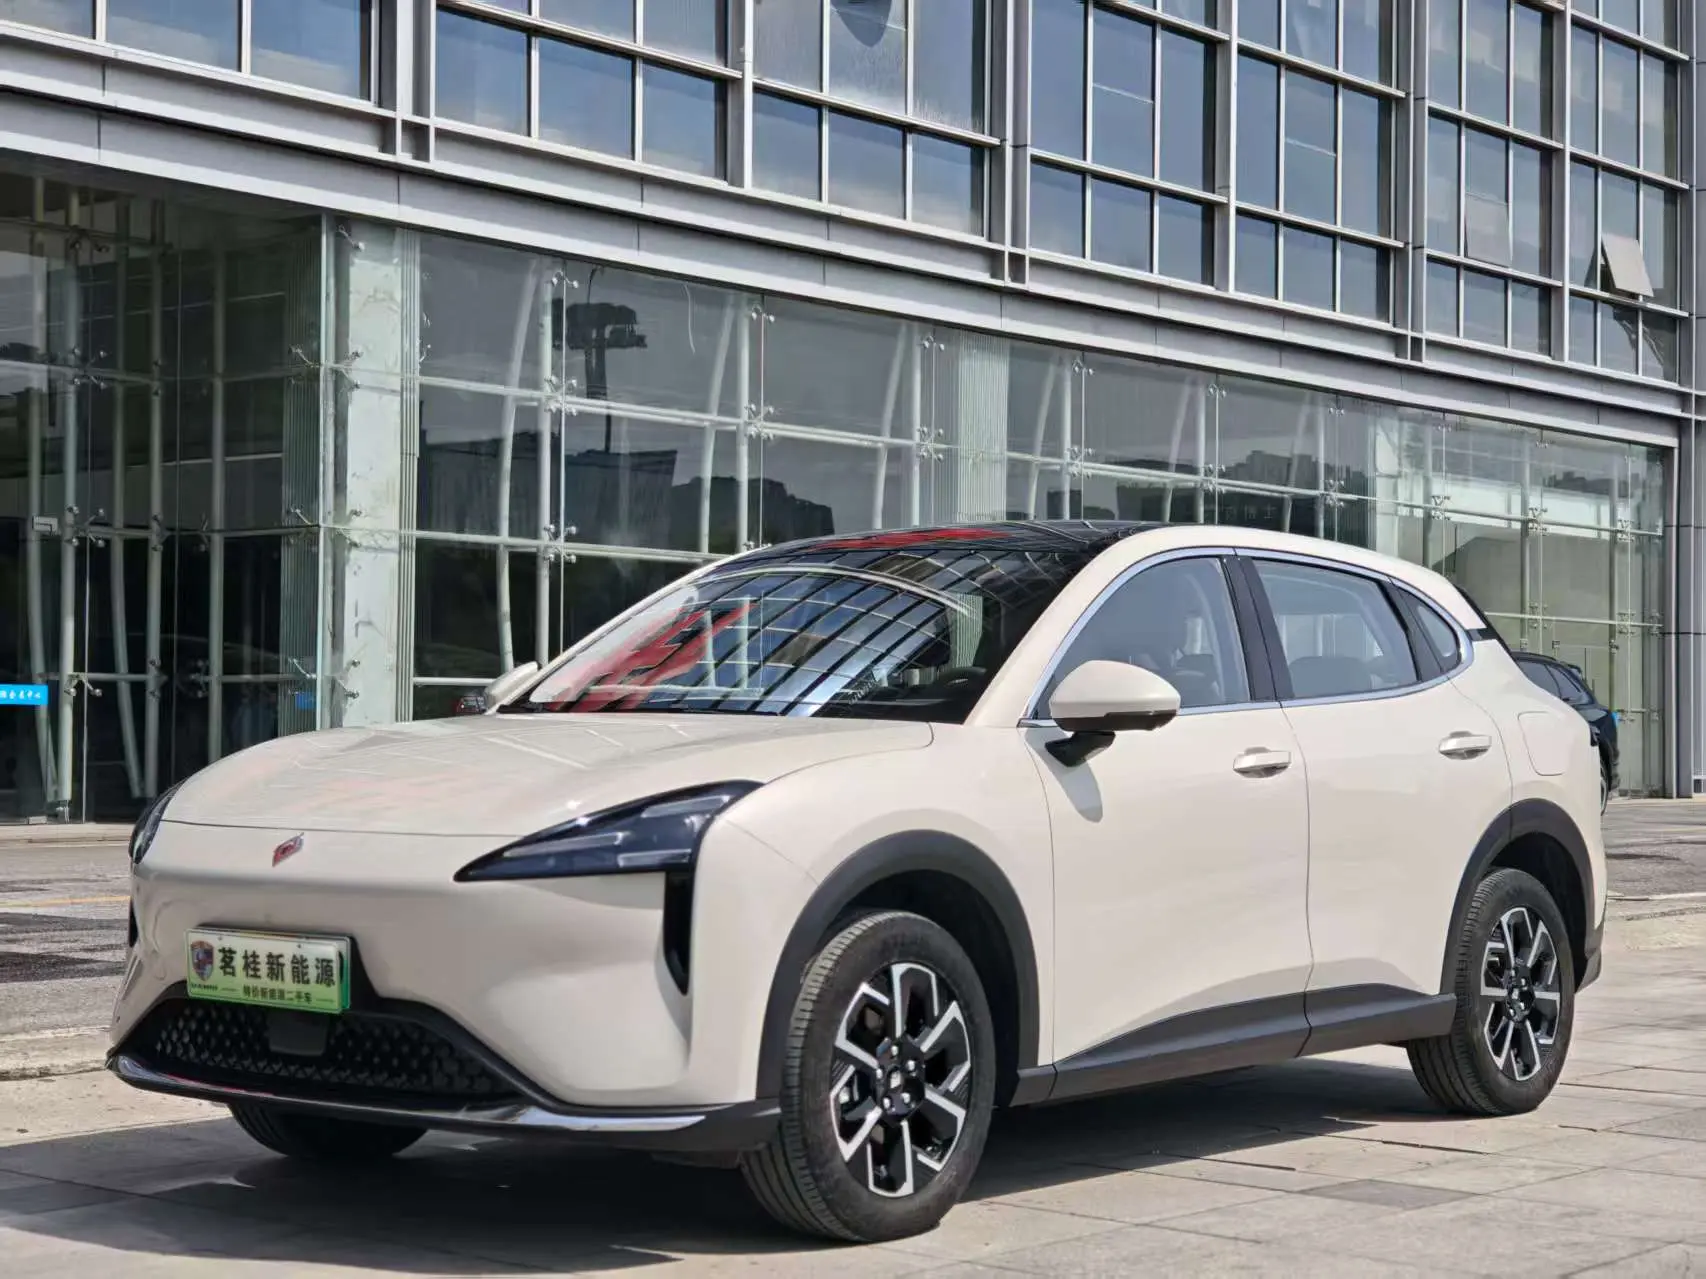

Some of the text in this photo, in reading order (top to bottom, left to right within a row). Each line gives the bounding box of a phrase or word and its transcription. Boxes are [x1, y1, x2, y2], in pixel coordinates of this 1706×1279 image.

[218, 946, 336, 988] 茗桂新能源
